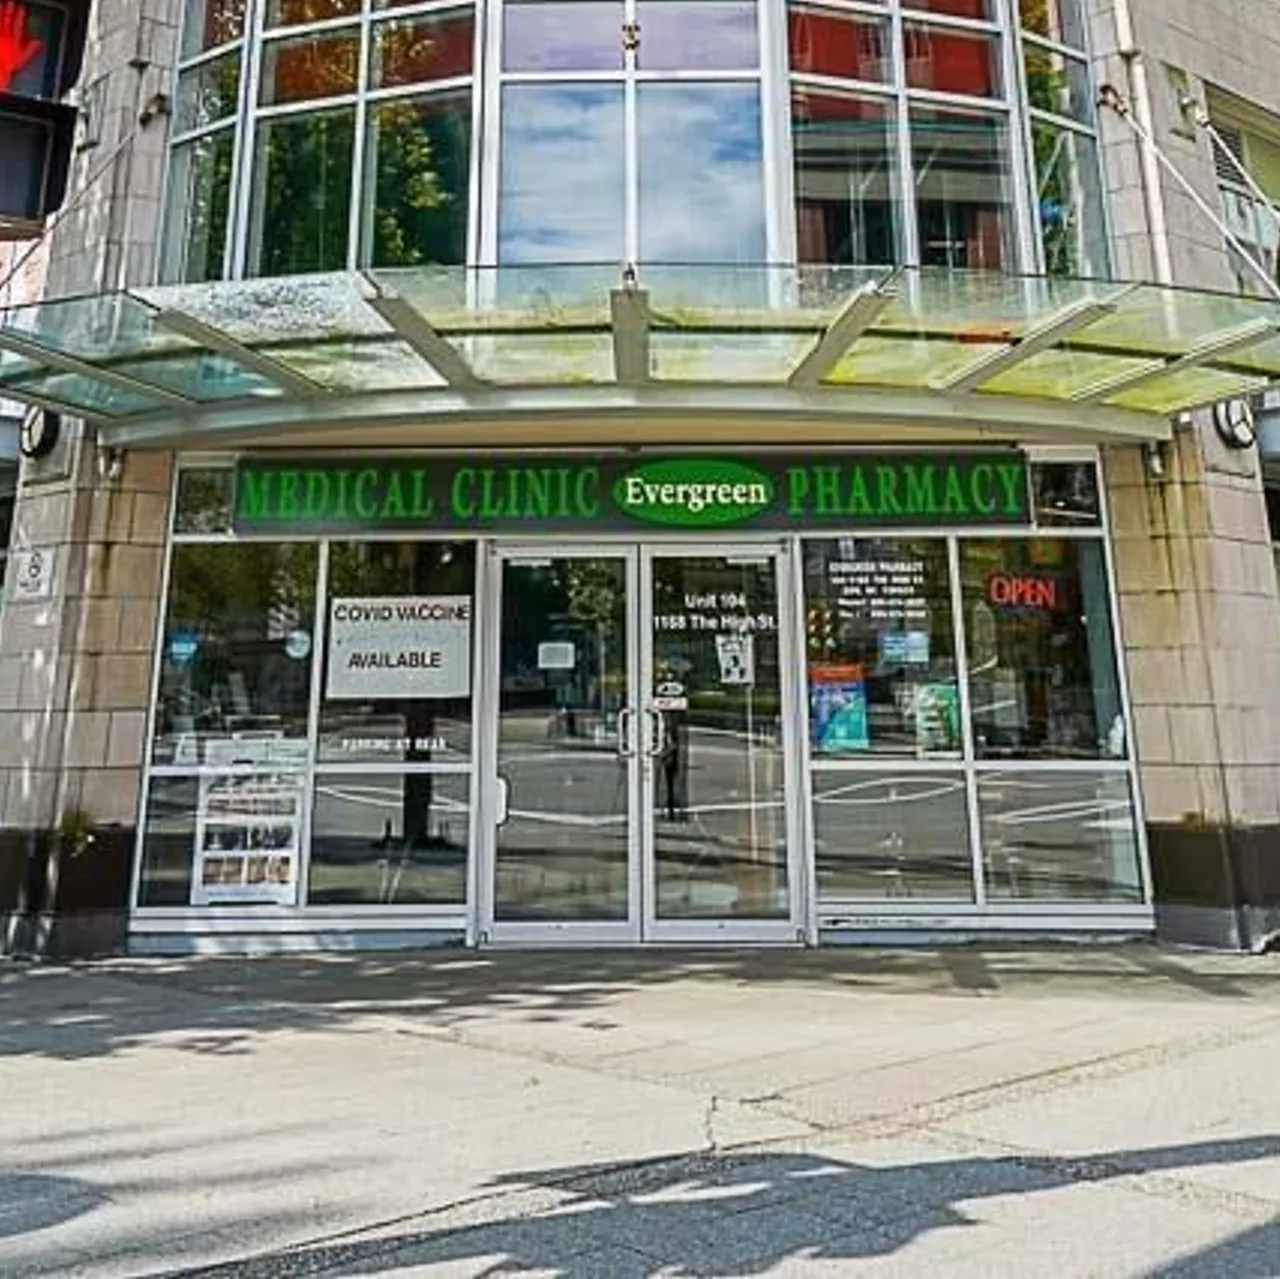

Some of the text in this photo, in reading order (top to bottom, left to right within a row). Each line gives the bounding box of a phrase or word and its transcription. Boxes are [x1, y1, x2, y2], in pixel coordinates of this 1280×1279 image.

[239, 467, 601, 520] MEDICAL CLINIC
[625, 478, 769, 512] Evergreen
[786, 465, 1021, 516] PHARMACY
[684, 593, 716, 608] Unit
[991, 576, 1056, 607] OPEN
[334, 603, 470, 621] COVID VACCINE
[348, 651, 443, 668] AVAILABLE
